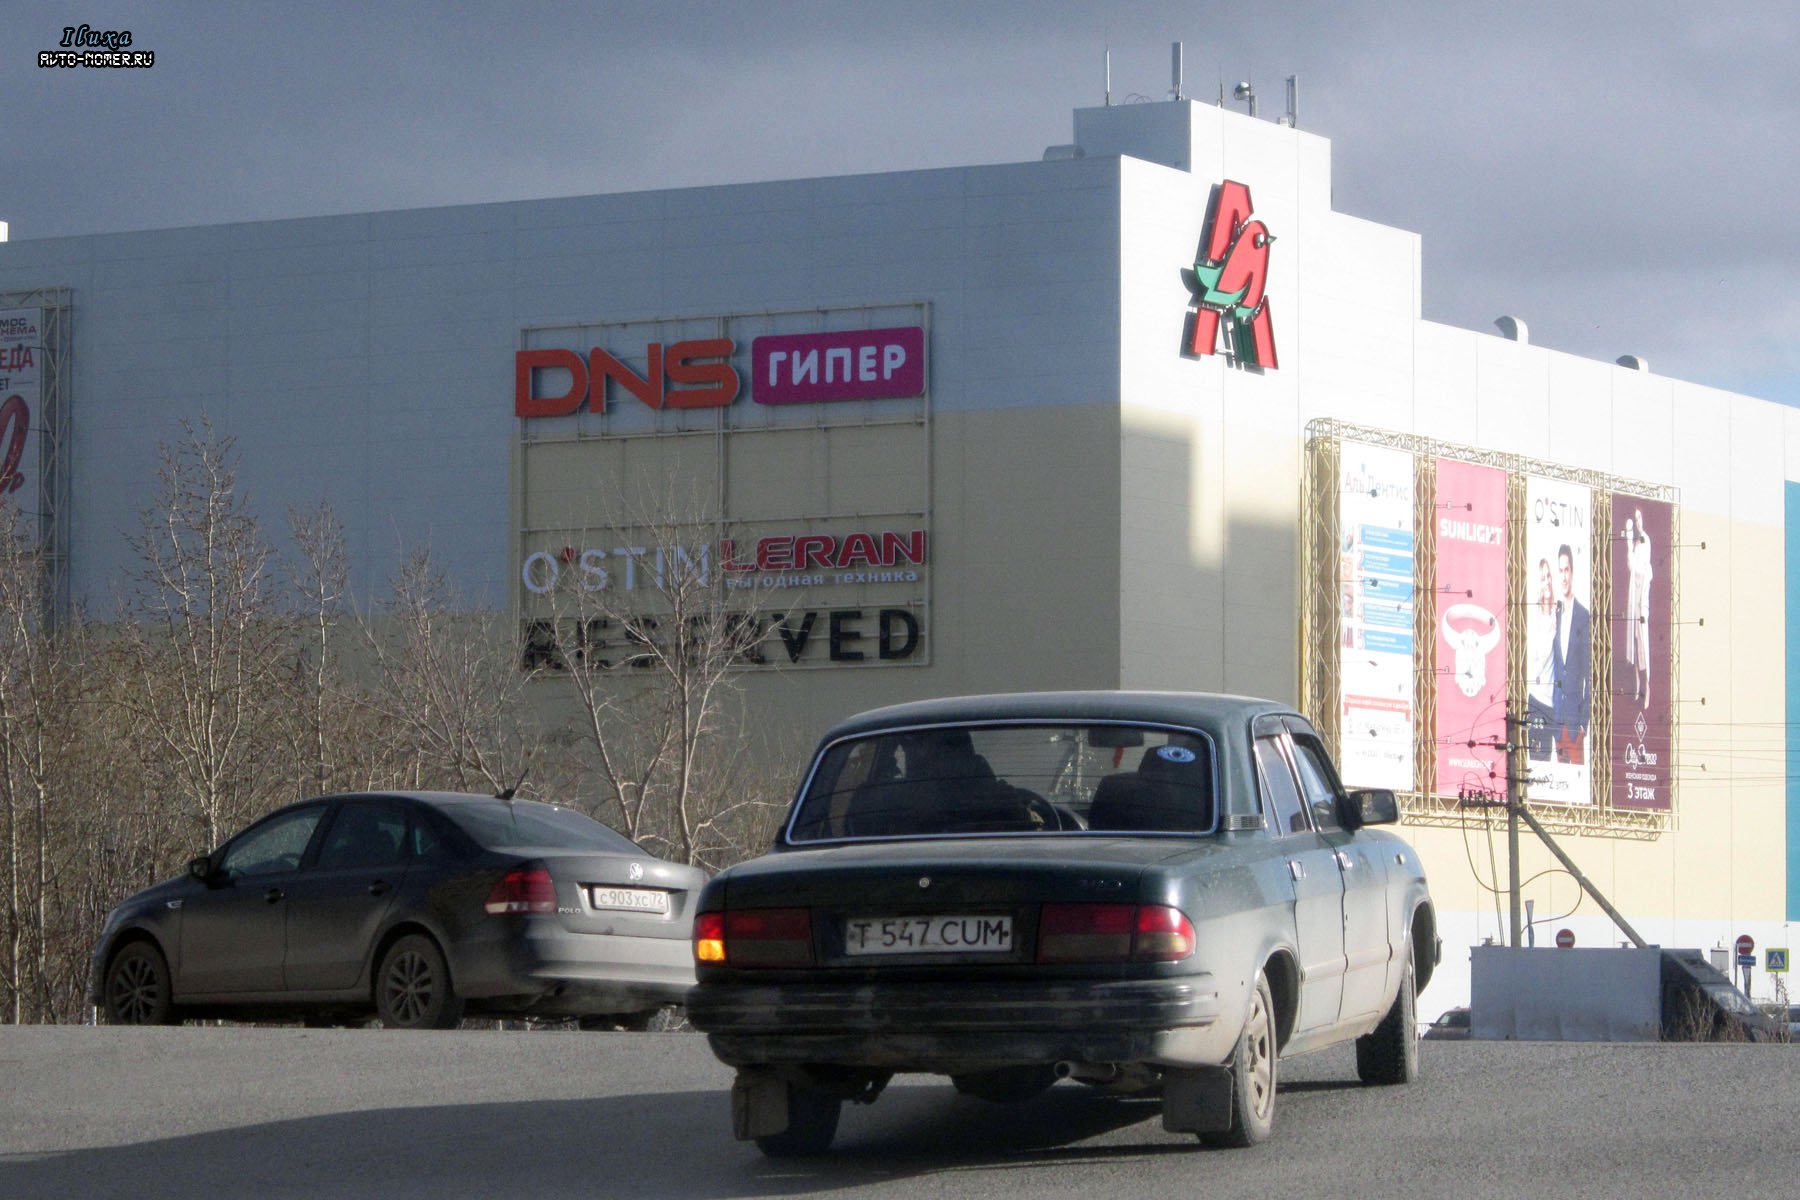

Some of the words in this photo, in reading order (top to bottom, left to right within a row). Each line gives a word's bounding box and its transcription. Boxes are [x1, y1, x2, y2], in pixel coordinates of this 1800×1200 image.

[515, 337, 740, 417] DNS
[769, 344, 907, 387] ГИПЕР
[1440, 518, 1502, 545] SUNLIGHT
[719, 530, 925, 571] LERAN
[523, 544, 710, 593] O'STIN
[835, 569, 918, 584] техника
[1627, 782, 1634, 799] 3
[1634, 786, 1655, 800] этаж
[882, 919, 930, 946] 547
[940, 919, 1003, 945] CUM
